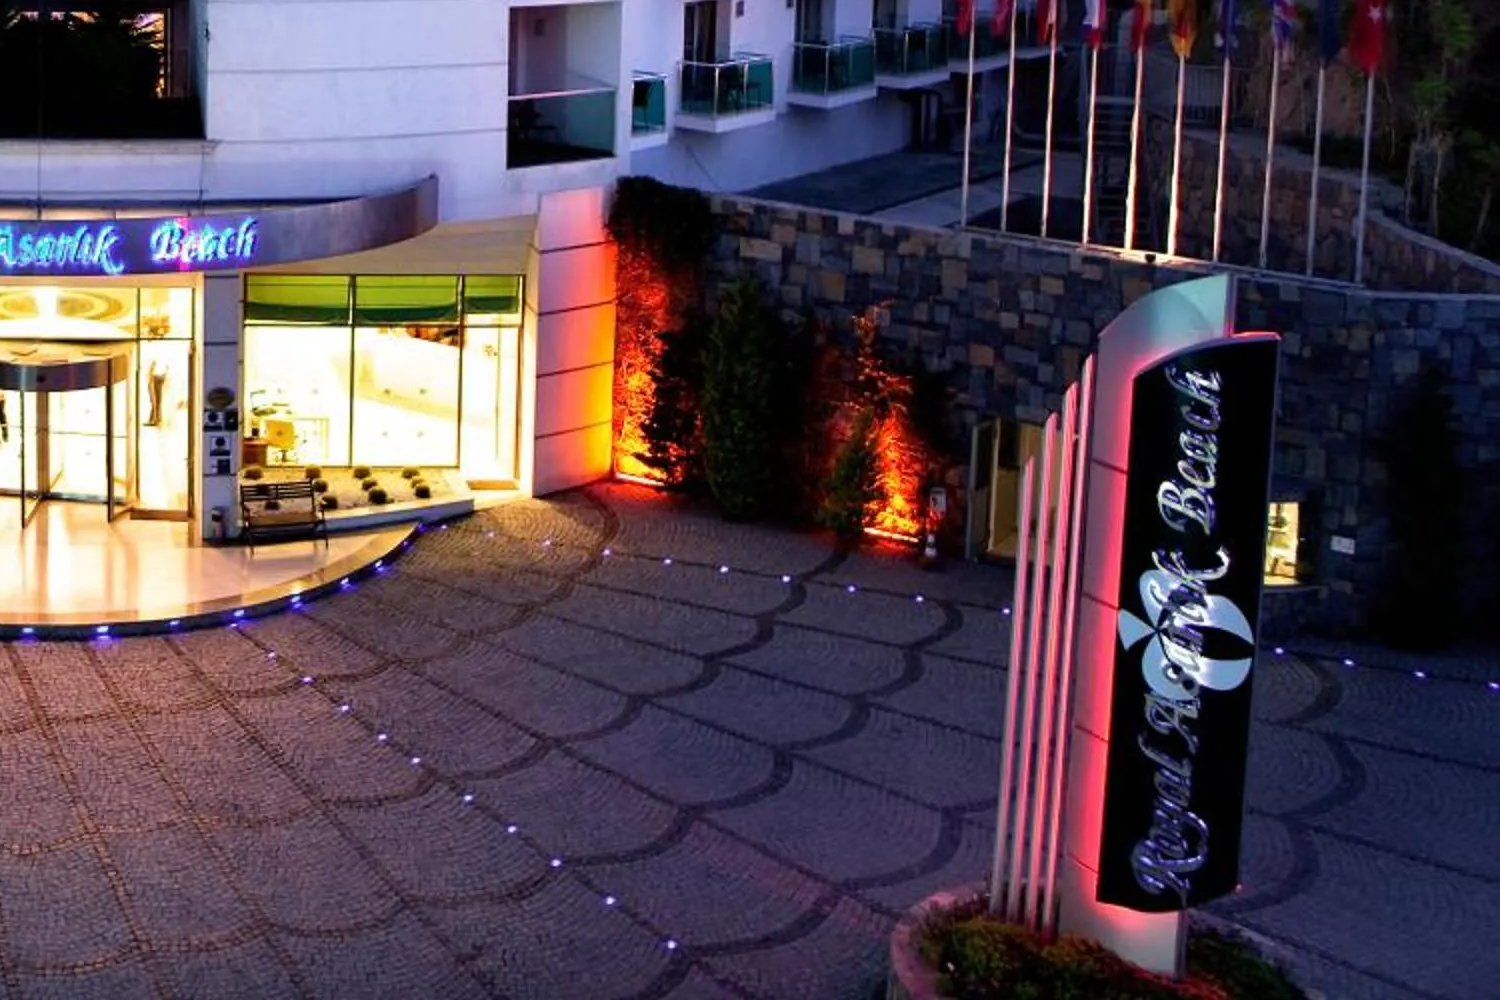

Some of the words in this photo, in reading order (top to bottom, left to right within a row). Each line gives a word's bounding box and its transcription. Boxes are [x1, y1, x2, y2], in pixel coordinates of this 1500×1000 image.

[151, 216, 258, 264] Beach
[1156, 364, 1224, 536] Beach
[1130, 732, 1210, 908] Royal
